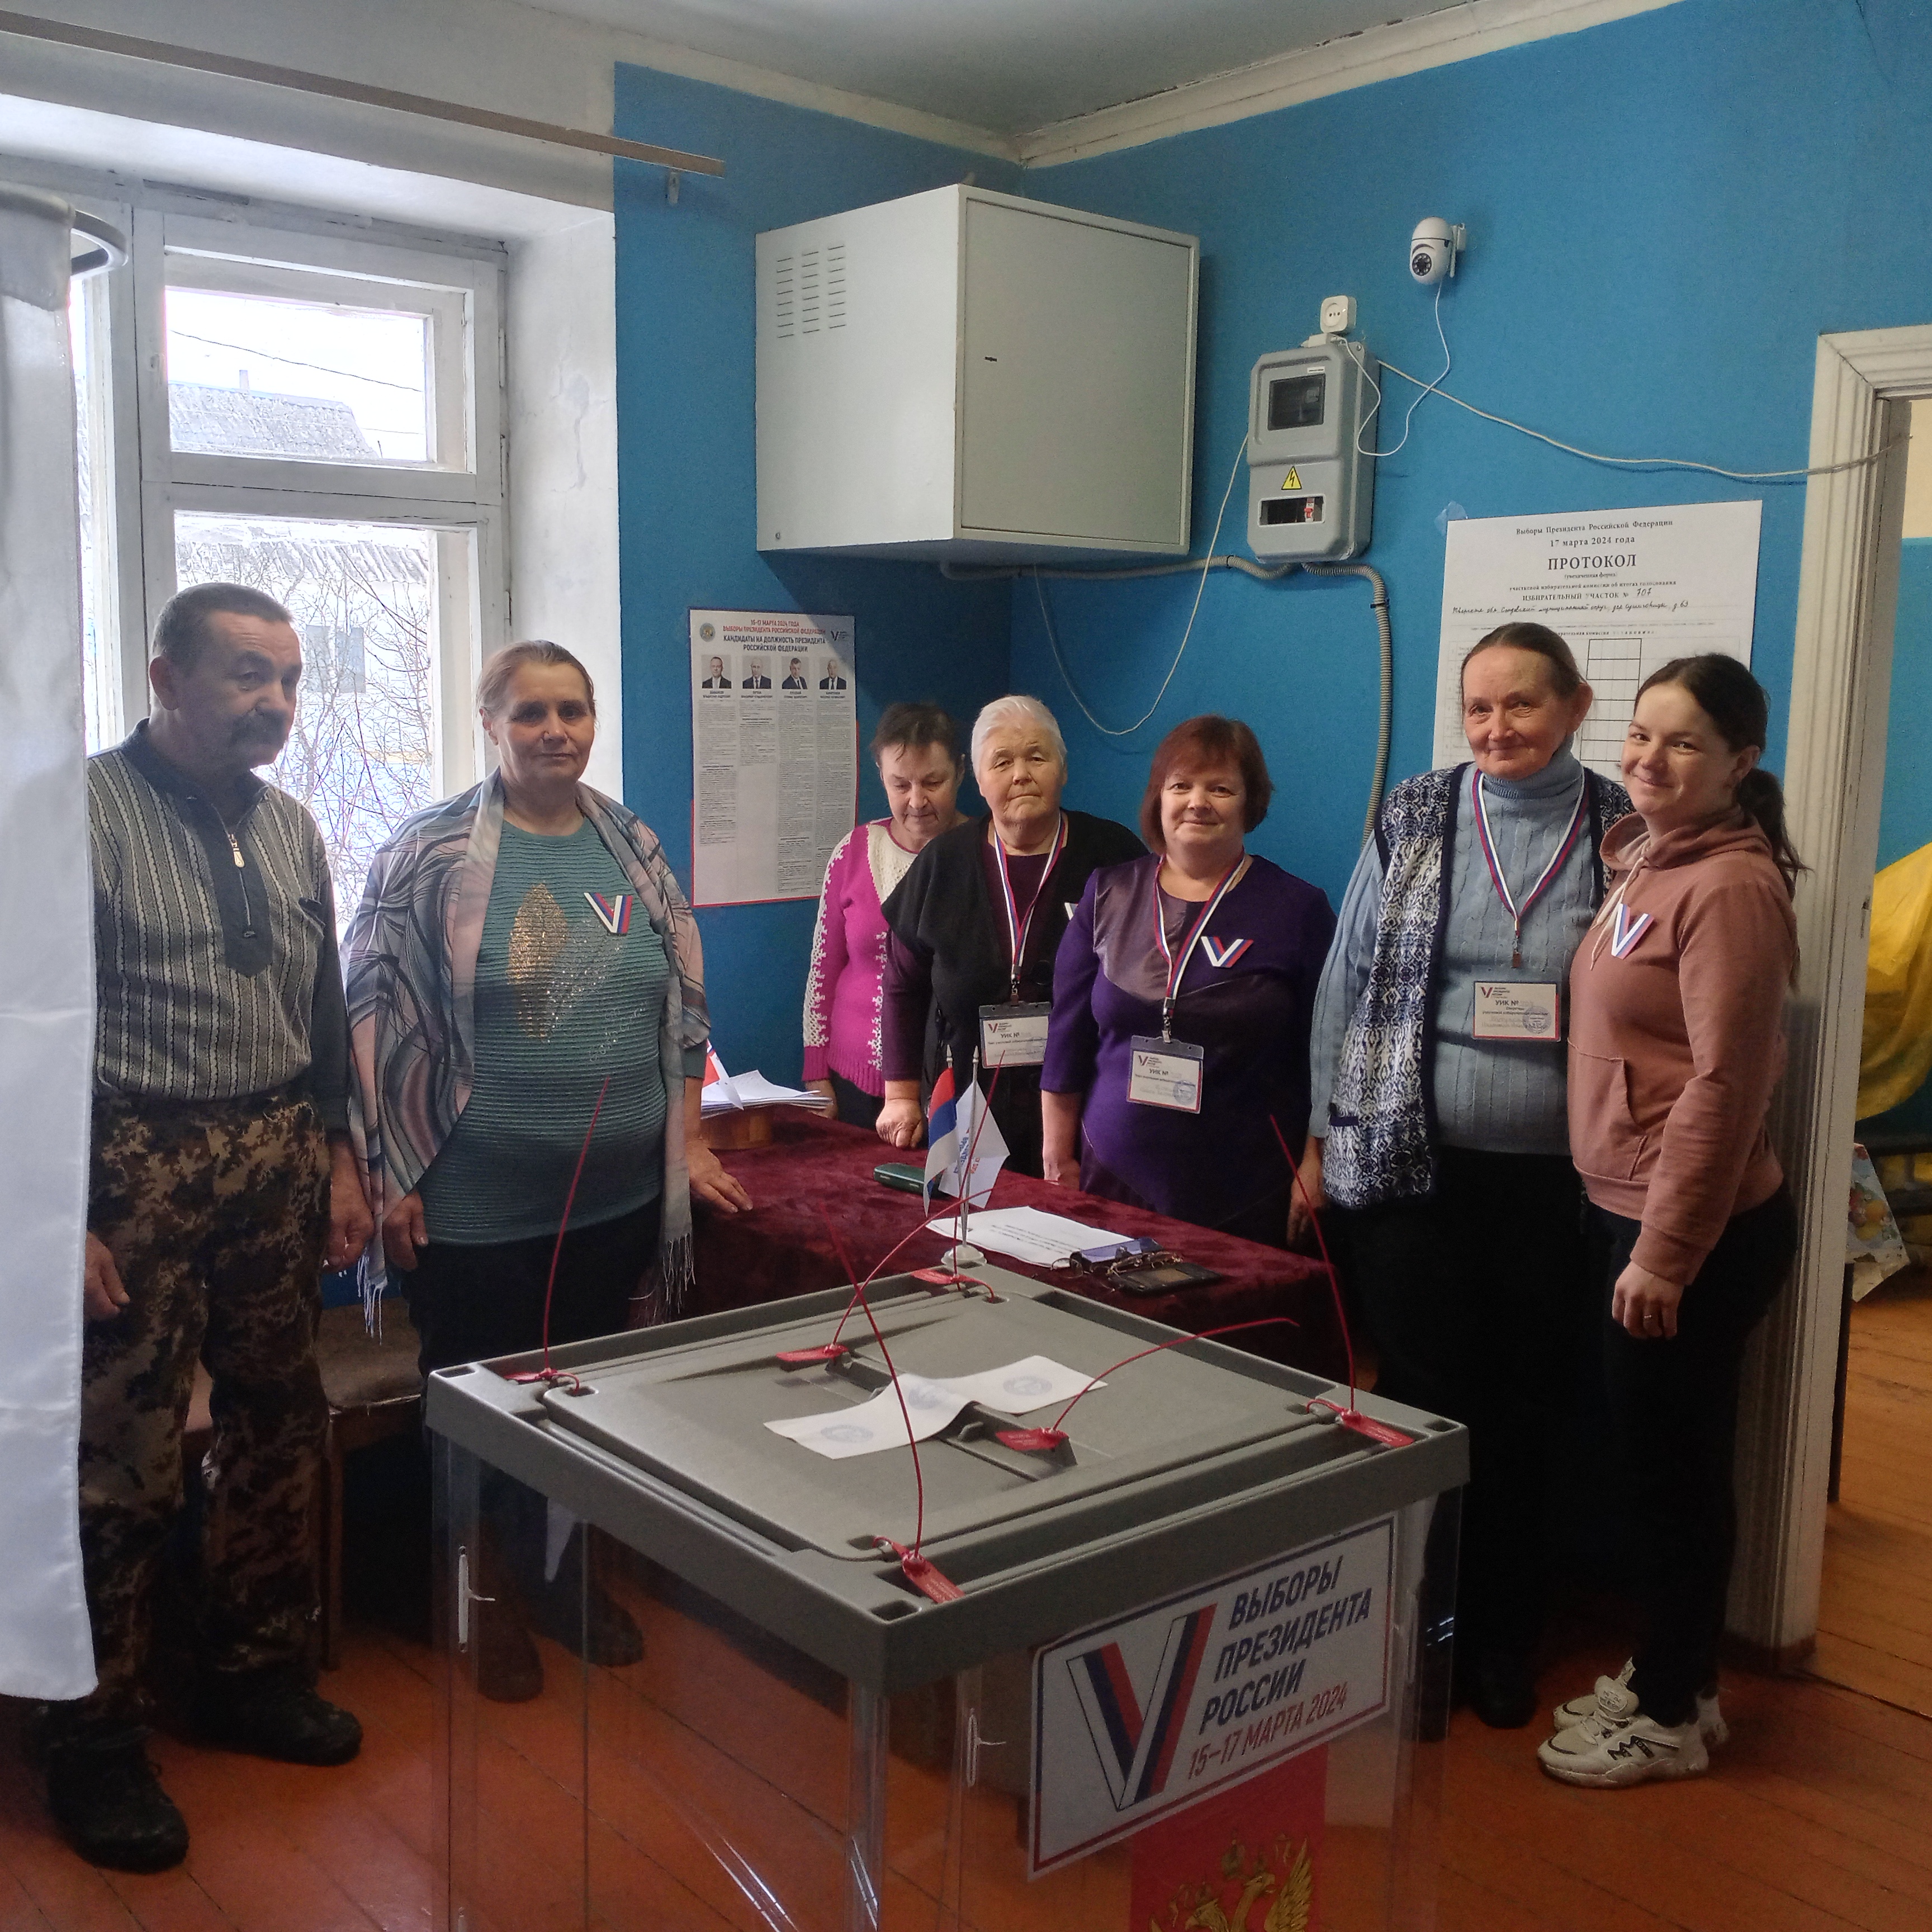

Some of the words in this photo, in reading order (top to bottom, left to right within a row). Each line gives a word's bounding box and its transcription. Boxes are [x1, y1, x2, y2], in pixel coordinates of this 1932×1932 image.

[1546, 525, 1585, 534] Президента
[1632, 520, 1673, 528] Федерации
[1562, 539, 1588, 548] марта
[1548, 554, 1637, 570] ПРОТОКОЛ
[1522, 593, 1582, 602] ИЗБИРАТЕЛЬНЫЙ
[1636, 588, 1652, 597] 707
[1229, 1555, 1344, 1630] ВЫБОРЫ
[1213, 1588, 1372, 1683] ПРЕЗИДЕНТА
[1199, 1659, 1306, 1735] РОССИИ
[1242, 1701, 1305, 1756] МАРТА
[1306, 1682, 1348, 1727] 2024
